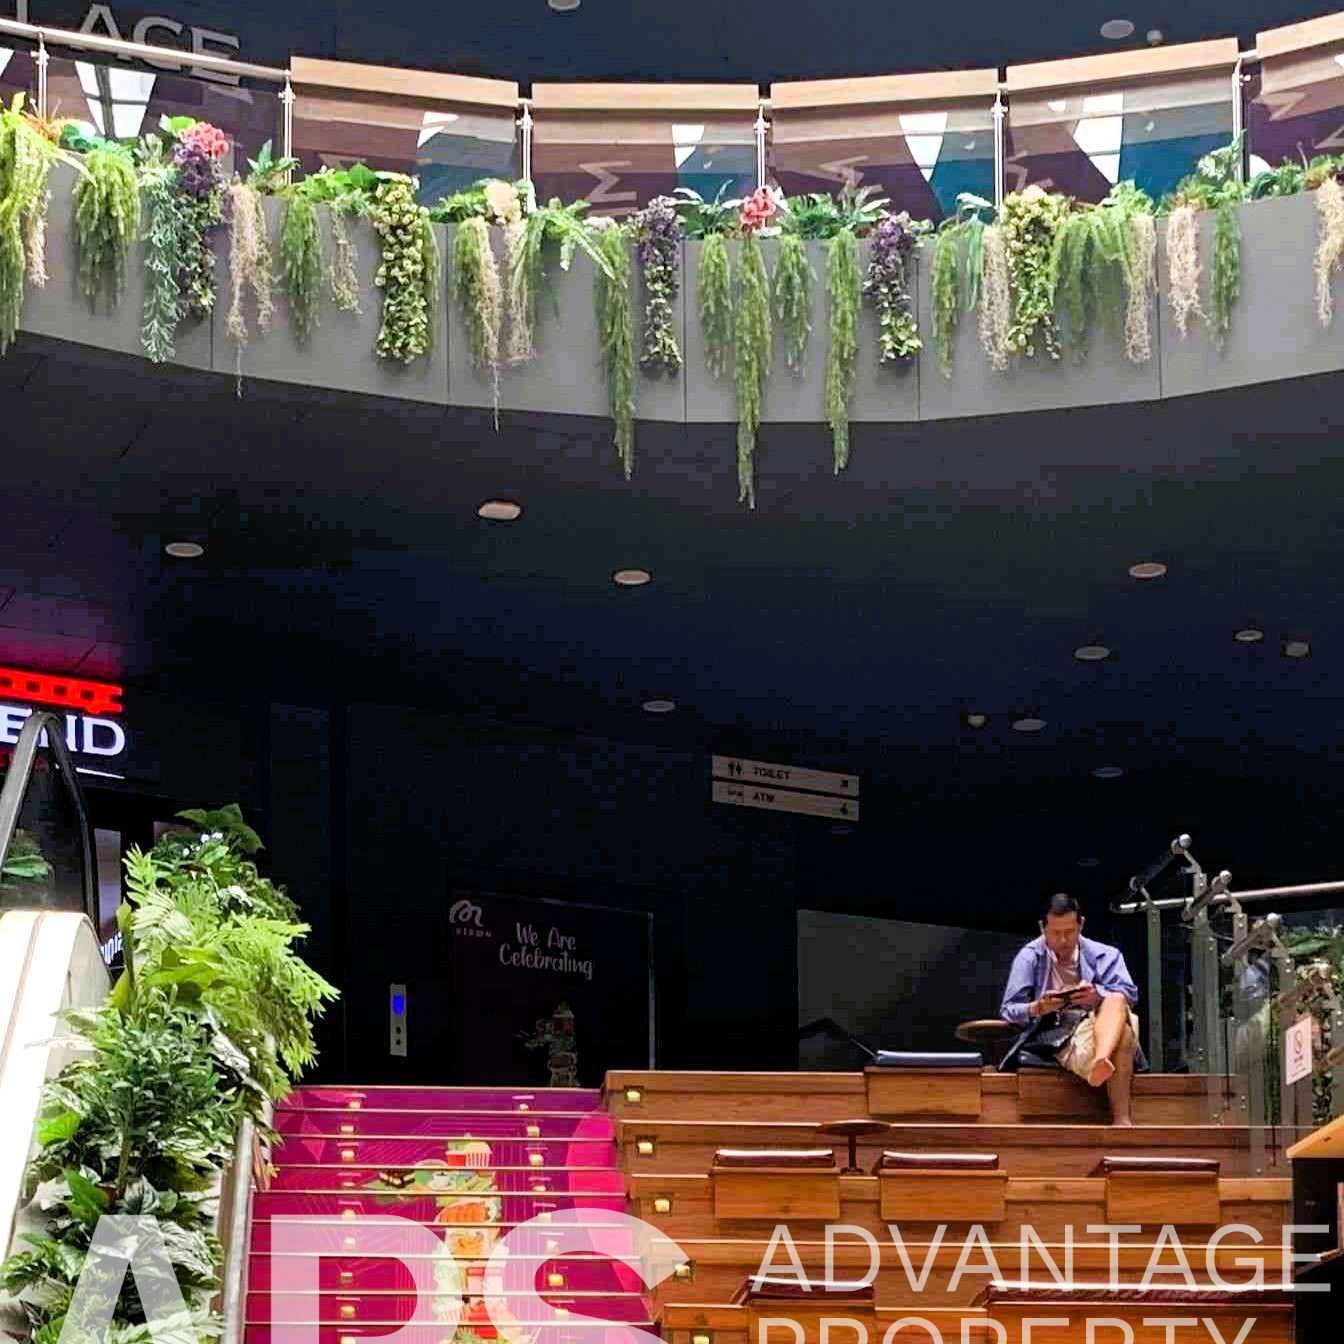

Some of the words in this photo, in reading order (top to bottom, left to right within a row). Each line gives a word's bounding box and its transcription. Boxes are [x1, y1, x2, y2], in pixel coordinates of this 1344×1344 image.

[752, 766, 791, 780] TOILET
[752, 792, 776, 803] ATM
[515, 921, 539, 946] We
[547, 926, 577, 951] Are
[499, 942, 593, 982] Celebrating
